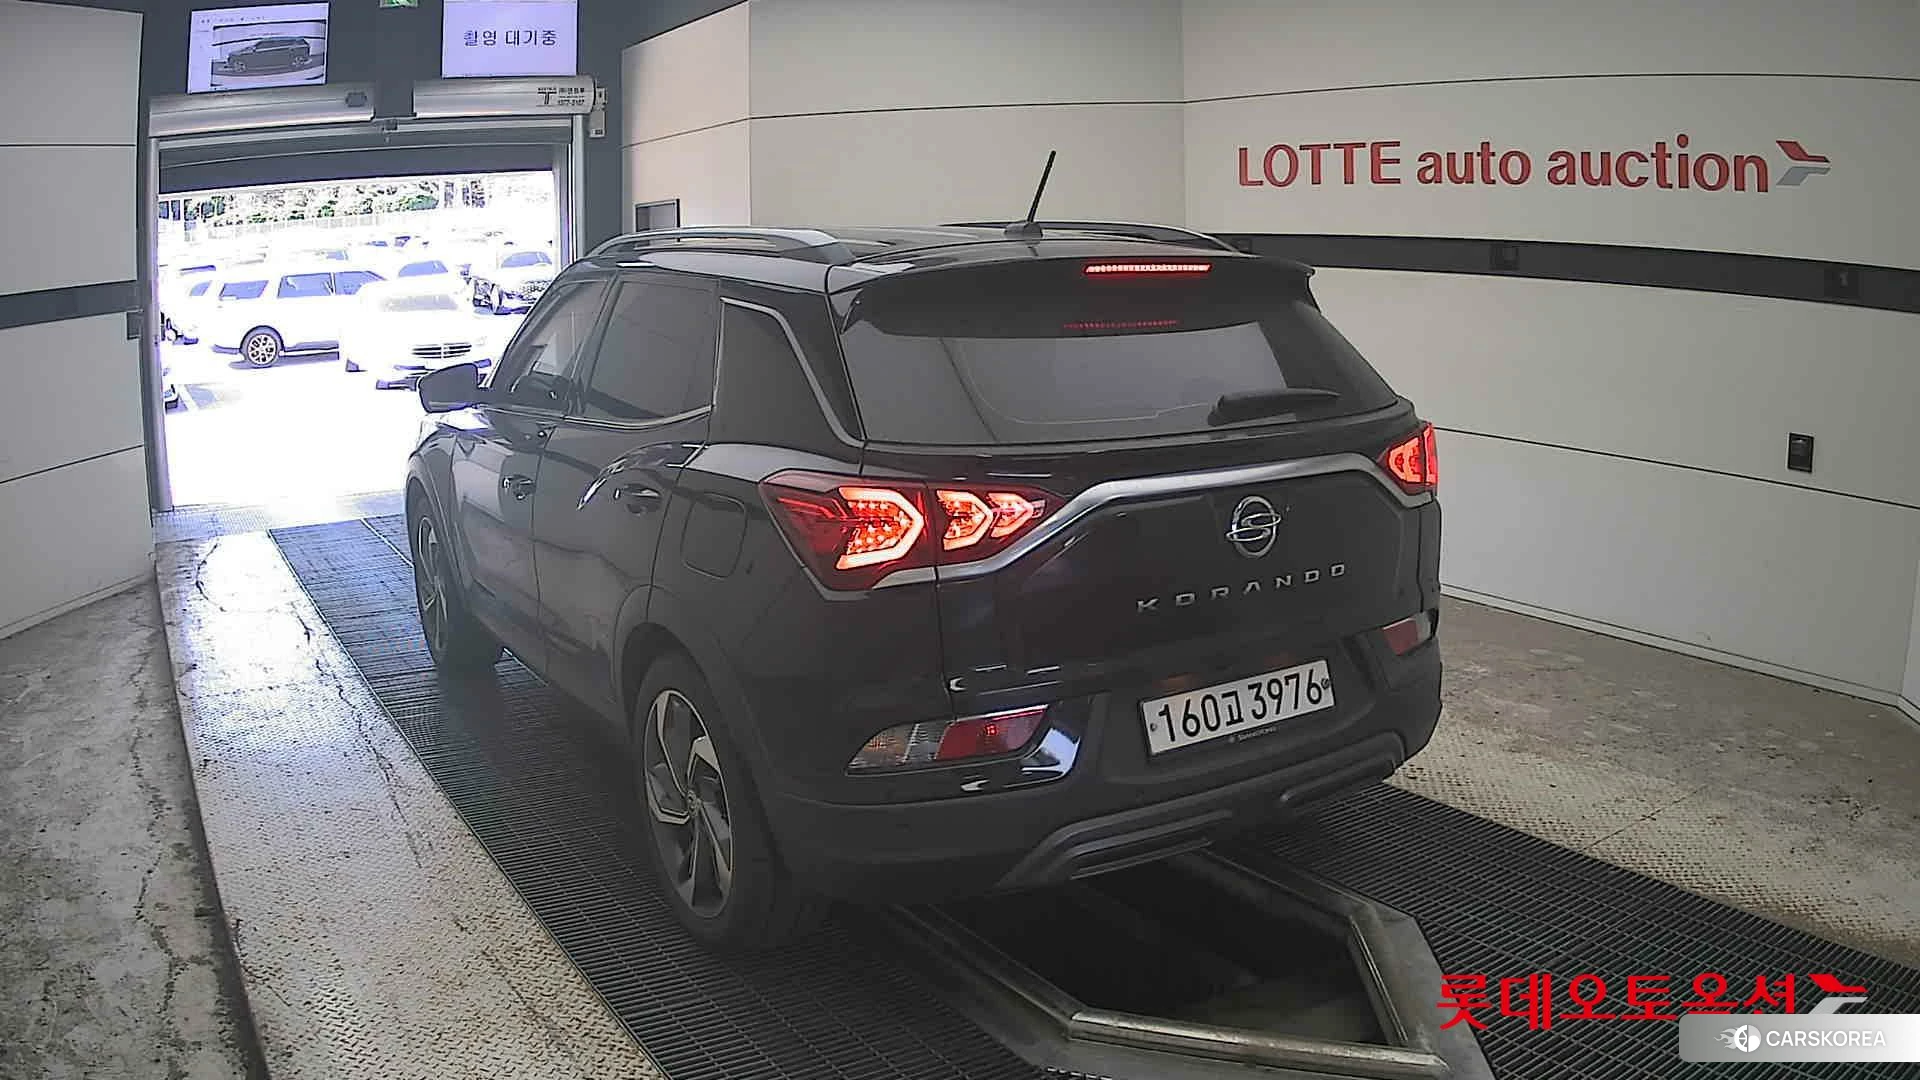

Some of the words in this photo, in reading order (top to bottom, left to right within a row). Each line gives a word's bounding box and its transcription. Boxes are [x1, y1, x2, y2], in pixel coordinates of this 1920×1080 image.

[506, 29, 557, 46] 대기중
[1238, 140, 1401, 187] LOTTE
[1416, 141, 1532, 186] auto
[1547, 134, 1769, 193] auction
[1136, 562, 1346, 613] KORANDO
